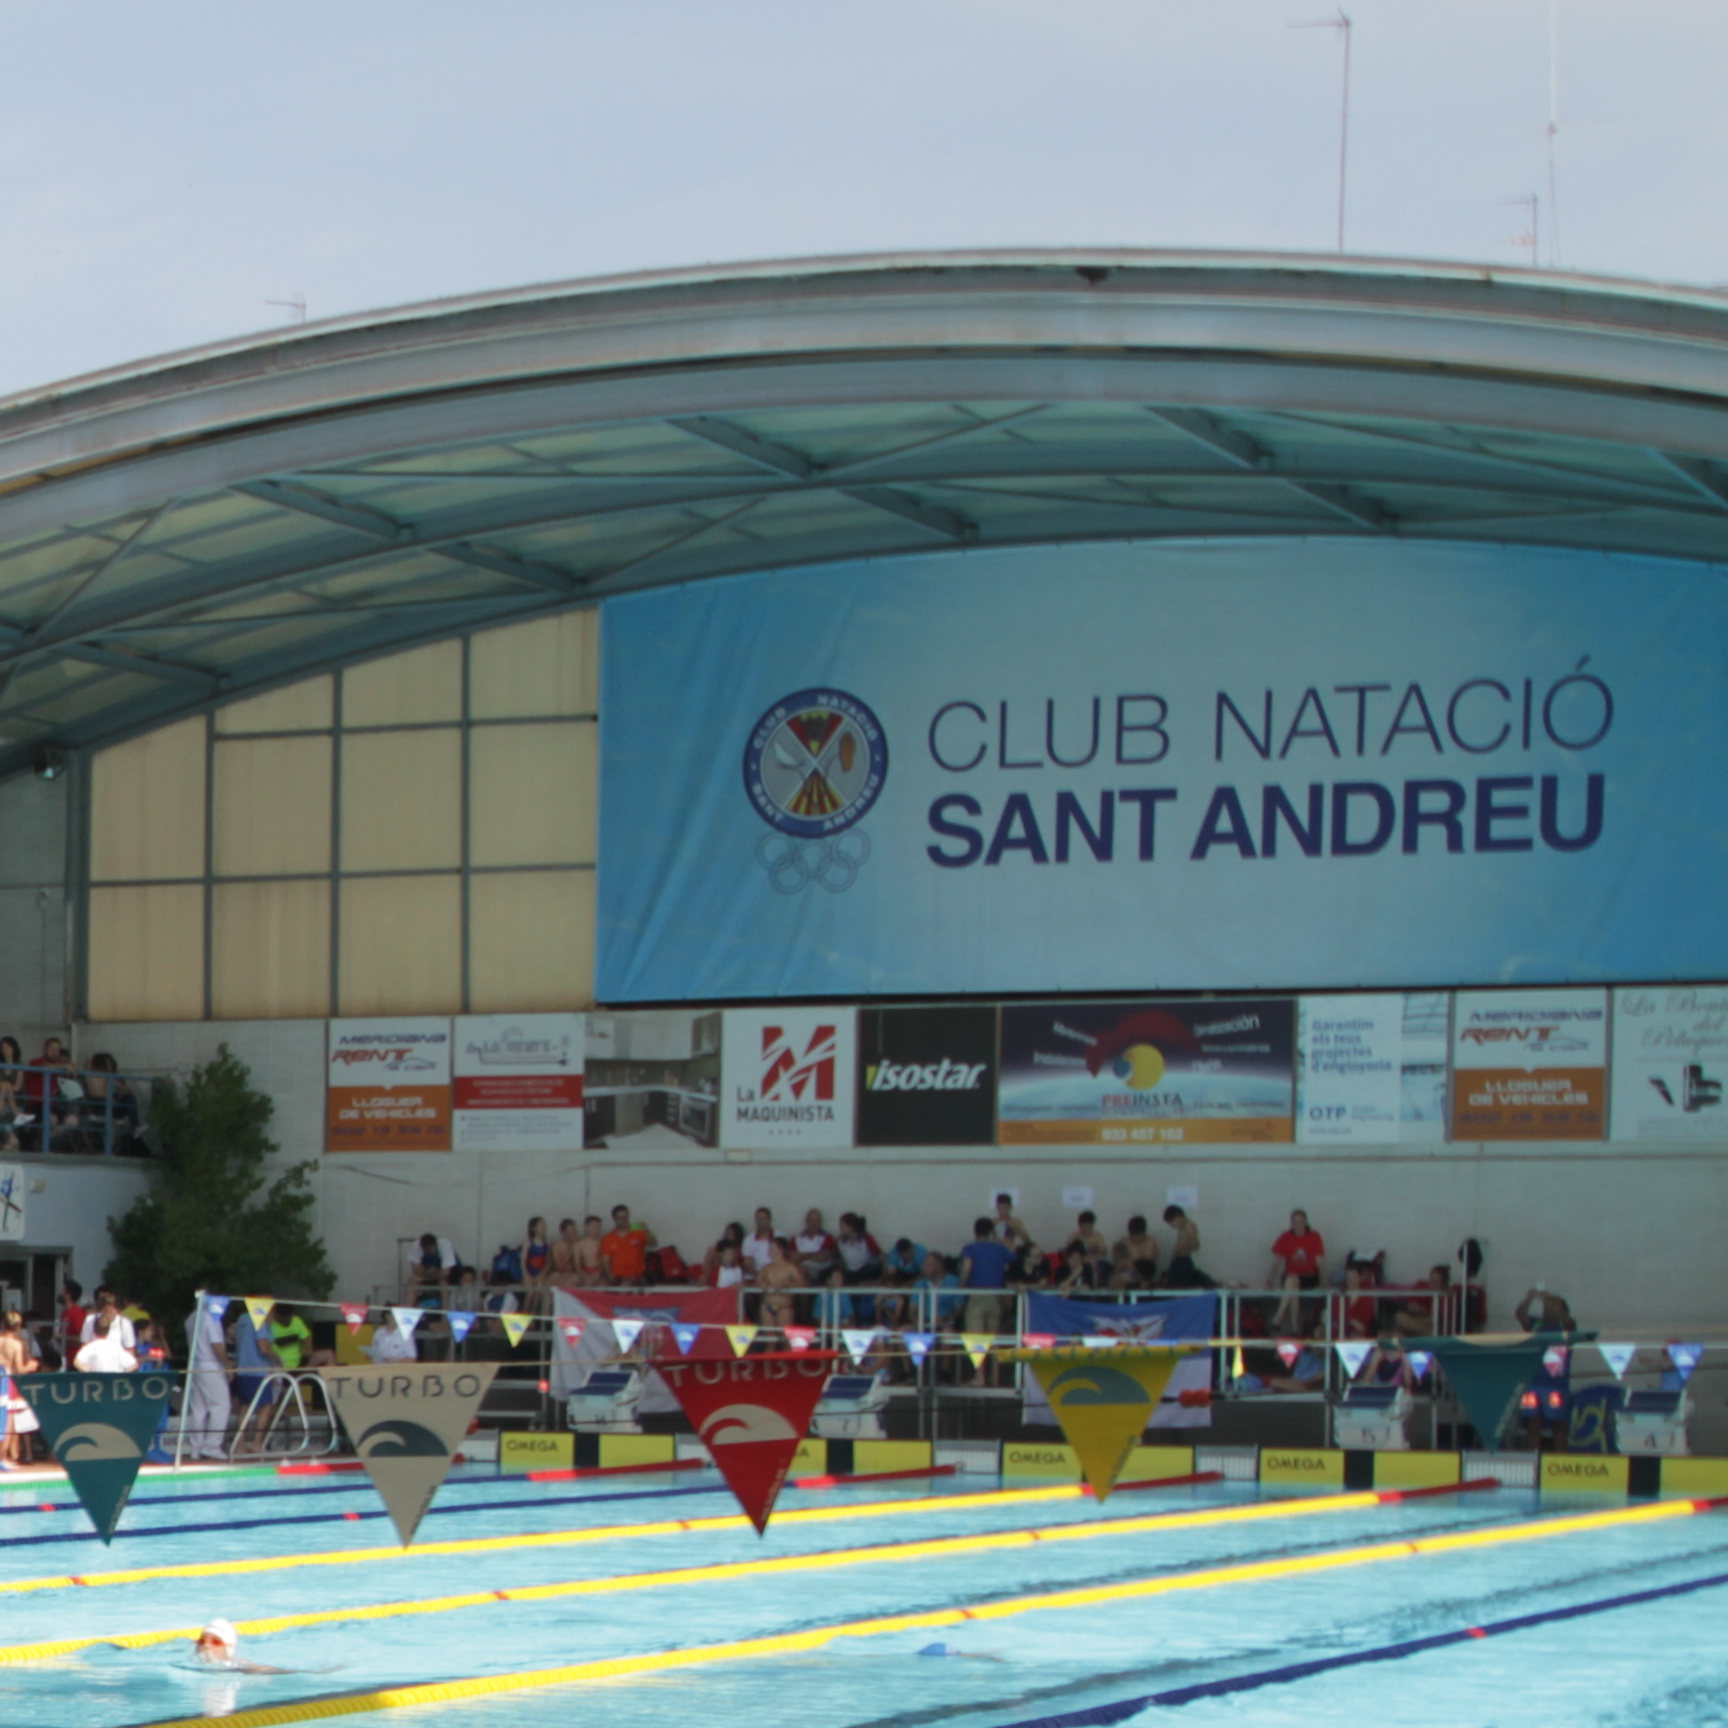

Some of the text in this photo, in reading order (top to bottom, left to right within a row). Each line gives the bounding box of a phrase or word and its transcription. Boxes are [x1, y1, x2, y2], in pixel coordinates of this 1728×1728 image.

[927, 655, 1615, 773] CLUB NATACIÓ
[926, 773, 1607, 869] SANT ANDREU
[872, 1057, 987, 1091] isostar
[736, 1086, 756, 1102] La
[735, 1105, 835, 1123] MAQUINISTA
[1309, 1106, 1347, 1121] OTP
[666, 1357, 830, 1388] TURBO
[23, 1376, 170, 1406] TURBO
[328, 1374, 481, 1399] TURBO
[506, 1439, 559, 1452] OMEGA
[1008, 1451, 1067, 1466] OMEGA
[1266, 1457, 1327, 1472] OMEGA
[1547, 1463, 1610, 1478] OMEGA
